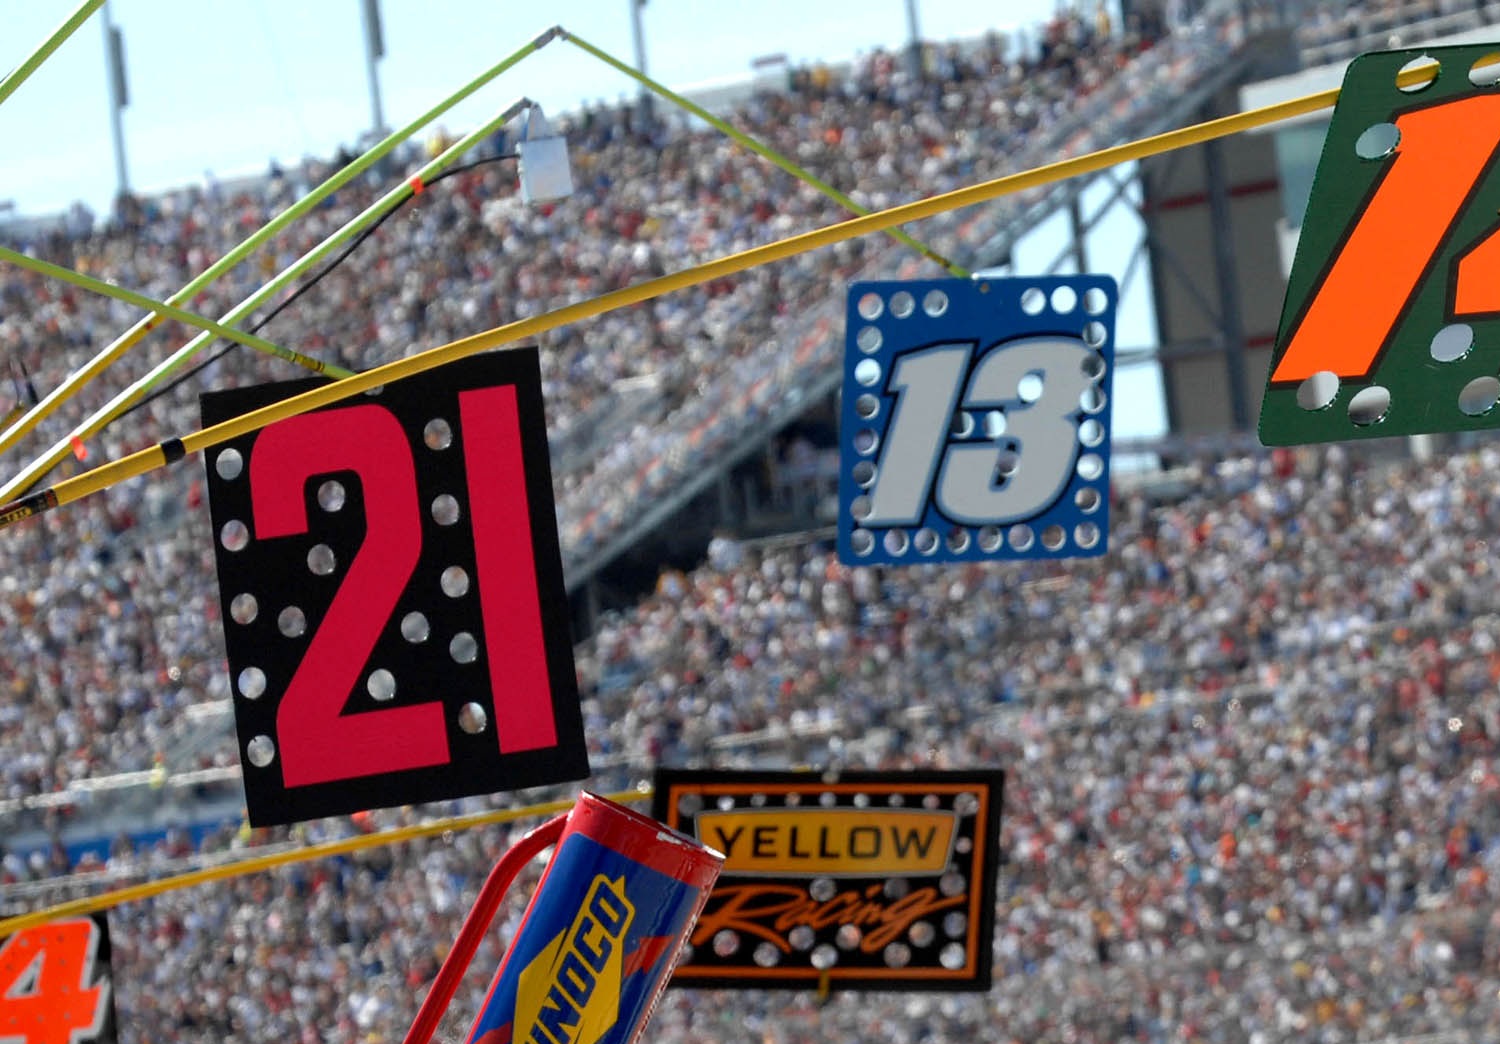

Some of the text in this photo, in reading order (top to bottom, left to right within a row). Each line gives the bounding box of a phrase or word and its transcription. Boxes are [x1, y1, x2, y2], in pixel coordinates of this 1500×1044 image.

[857, 332, 1104, 528] 13
[249, 384, 558, 789] 21
[715, 826, 938, 859] YELLOW
